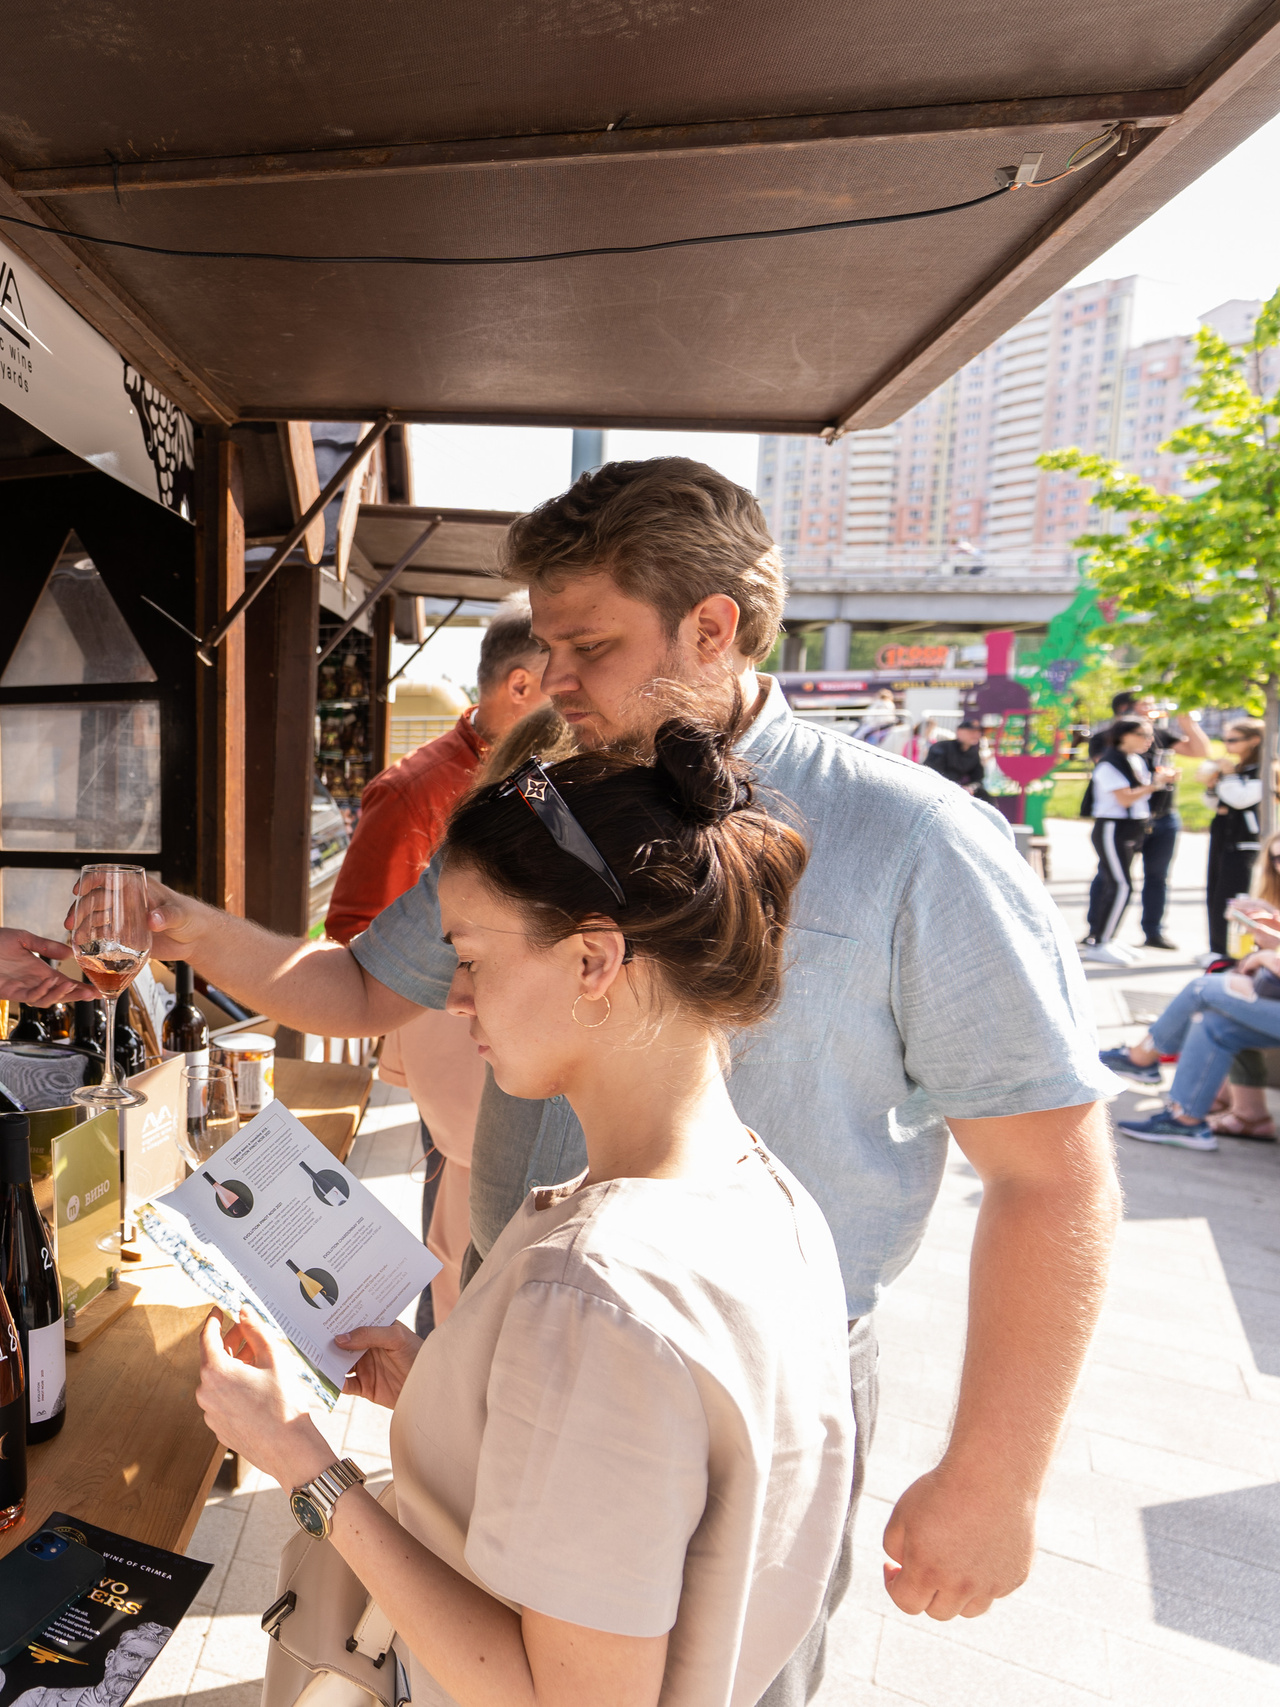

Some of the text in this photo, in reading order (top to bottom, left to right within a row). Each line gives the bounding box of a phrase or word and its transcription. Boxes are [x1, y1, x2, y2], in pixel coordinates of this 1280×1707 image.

[9, 344, 33, 373] wine
[84, 1179, 111, 1208] ВИНО
[103, 1552, 124, 1564] WINE
[140, 1565, 173, 1580] CRIMEA
